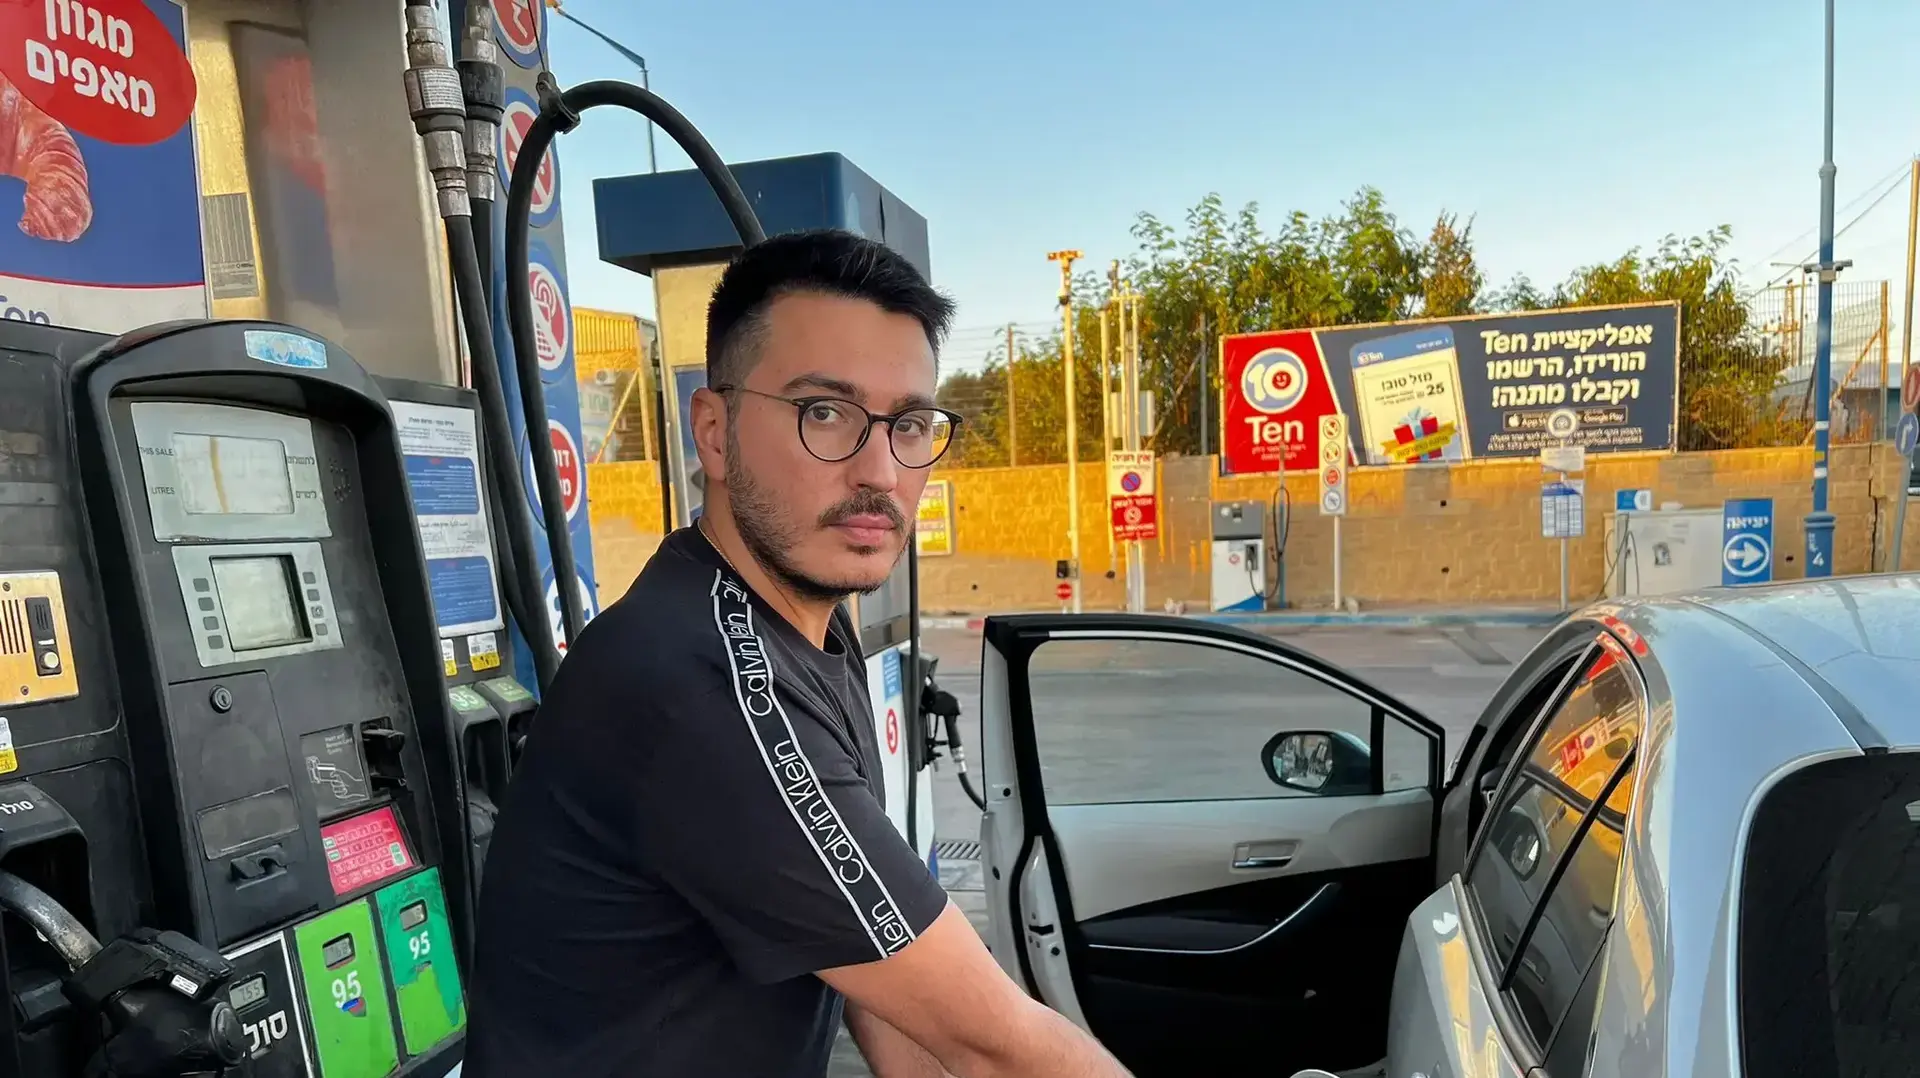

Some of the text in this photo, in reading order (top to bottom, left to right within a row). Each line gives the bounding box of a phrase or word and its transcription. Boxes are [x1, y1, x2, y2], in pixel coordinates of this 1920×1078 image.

[44, 0, 134, 58] מגוון
[25, 38, 156, 117] מאפים
[1480, 322, 1653, 354] אפליקציית Ten
[1409, 371, 1433, 385] מזל
[1486, 356, 1564, 380] הרשמו
[1426, 382, 1445, 397] 25
[1491, 376, 1640, 408] וקבלו מתנה!
[1244, 415, 1304, 445] Ten
[155, 448, 174, 456] SALE
[151, 486, 175, 495] LITRES
[735, 642, 773, 716] Calvin
[774, 739, 864, 884] Calvin Klein
[871, 900, 912, 955] lein
[409, 931, 431, 960] 95
[331, 970, 362, 1009] 95
[242, 1009, 288, 1053] סול
